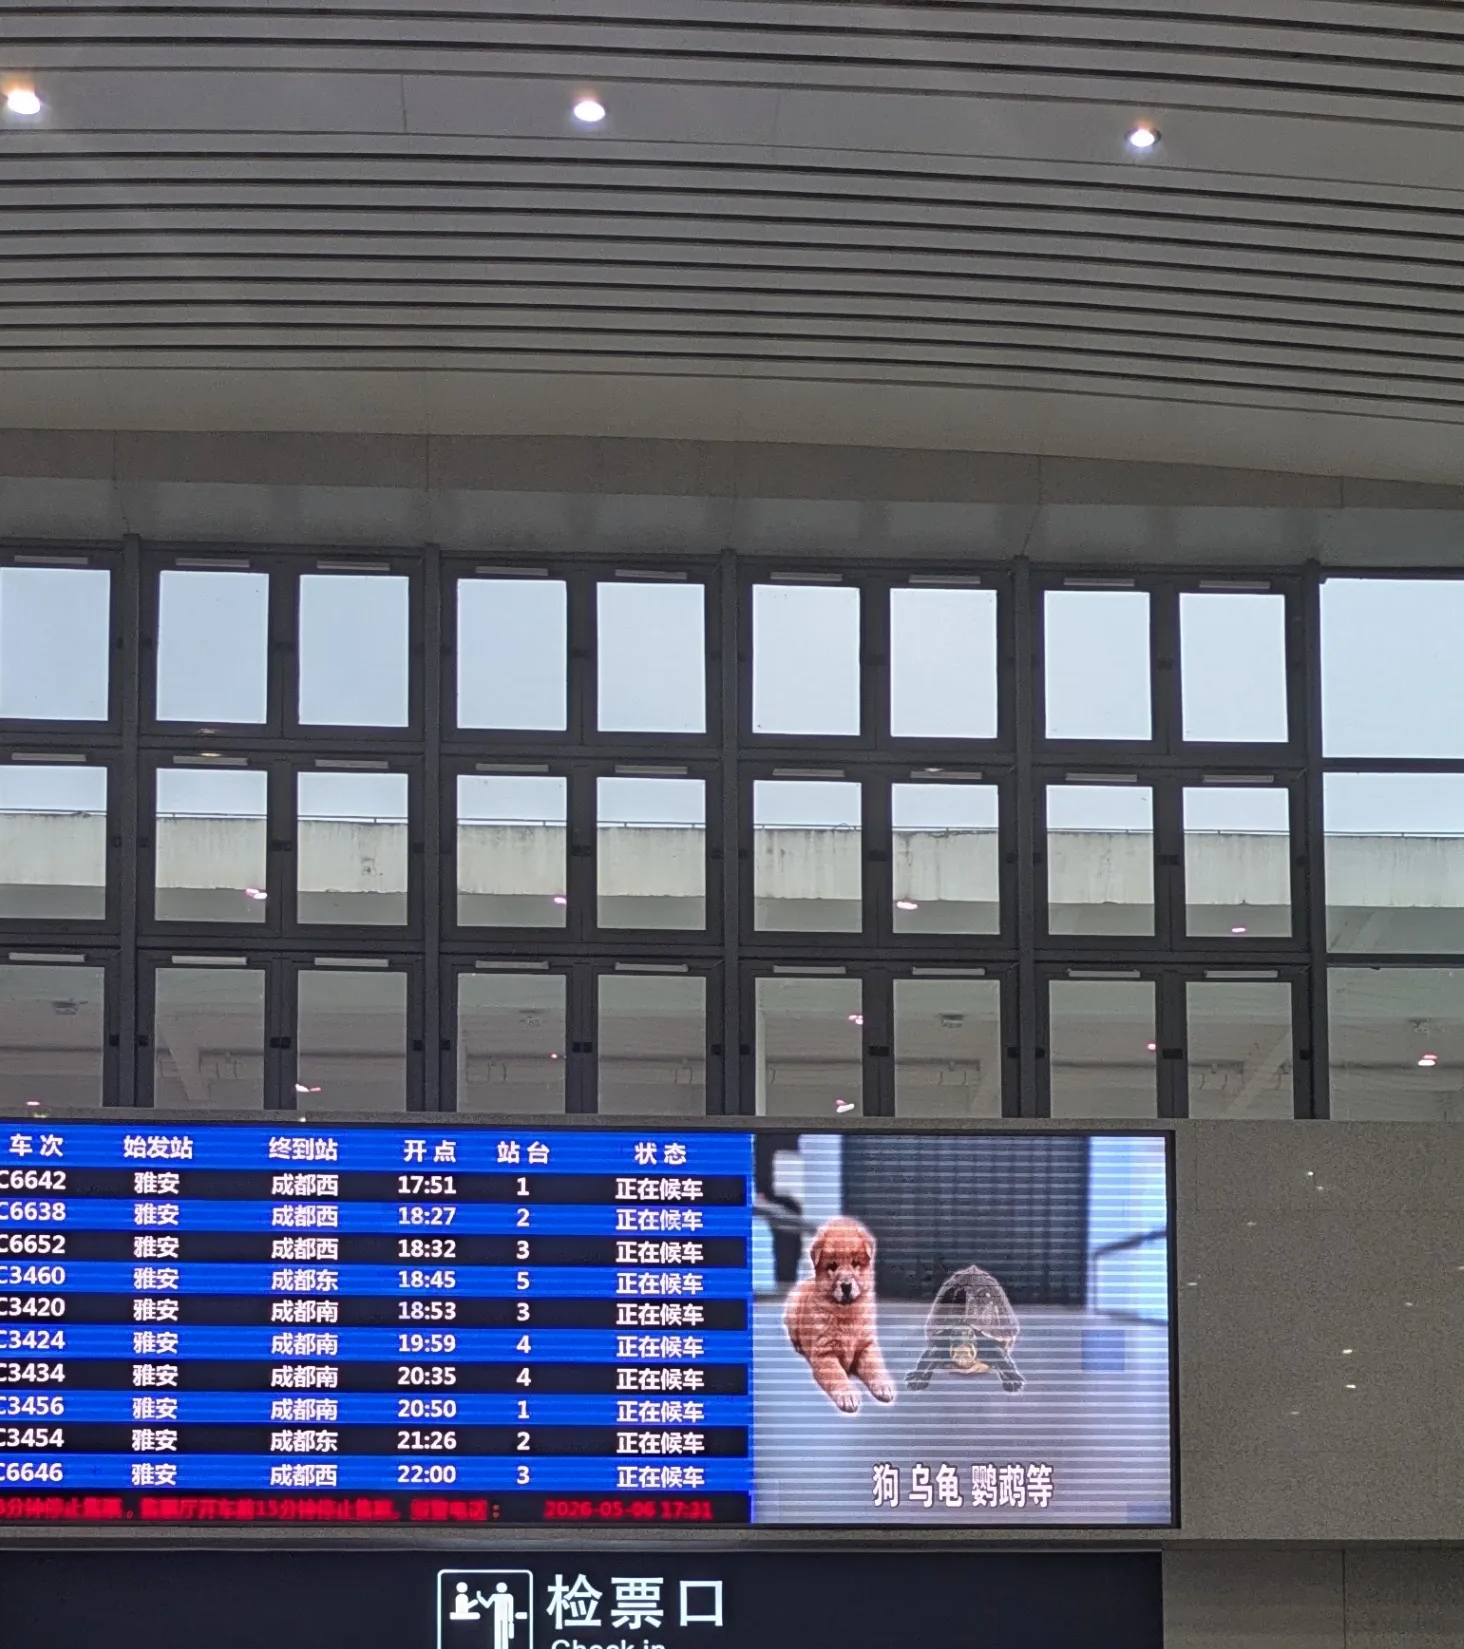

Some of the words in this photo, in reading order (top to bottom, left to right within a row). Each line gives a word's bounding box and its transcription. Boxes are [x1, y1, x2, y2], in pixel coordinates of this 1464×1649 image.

[124, 1136, 193, 1159] 始发站
[269, 1137, 337, 1160] 终到站
[134, 1172, 179, 1194] 雅安
[272, 1173, 338, 1196] 成都西
[399, 1176, 456, 1194] 17:51
[517, 1177, 529, 1195] 1
[615, 1178, 703, 1200] 正在候车
[134, 1203, 179, 1225] 雅安
[272, 1205, 338, 1227] 成都西
[399, 1207, 456, 1225] 18:27
[517, 1209, 529, 1226] 2
[616, 1209, 703, 1231] 正在候车
[134, 1236, 179, 1258] 雅安
[272, 1237, 338, 1260] 成都西
[399, 1240, 455, 1257] 18:32
[517, 1241, 529, 1259] 3
[616, 1241, 703, 1263] 正在候车
[134, 1267, 179, 1289] 雅安
[272, 1269, 338, 1291] 成都东
[399, 1271, 455, 1288] 18:45
[518, 1272, 529, 1289] 5
[616, 1273, 703, 1294] 正在候车
[134, 1299, 178, 1321] 雅安
[271, 1300, 338, 1322] 成都南
[399, 1302, 456, 1319] 18:53
[517, 1303, 529, 1321] 3
[616, 1303, 704, 1325] 正在候车
[134, 1331, 178, 1353] 雅安
[272, 1332, 338, 1355] 成都南
[399, 1334, 455, 1352] 19:59
[517, 1335, 531, 1353] 4
[617, 1336, 704, 1358] 正在候车
[133, 1364, 178, 1386] 雅安
[271, 1365, 338, 1387] 成都南
[398, 1367, 456, 1385] 20:35
[517, 1368, 531, 1386] 4
[616, 1368, 704, 1390] 正在候车
[133, 1397, 177, 1419] 雅安
[271, 1398, 338, 1420] 成都南
[398, 1400, 456, 1417] 20:50
[518, 1401, 529, 1418] 1
[617, 1401, 704, 1422] 正在候车
[132, 1429, 177, 1451] 雅安
[271, 1430, 338, 1452] 成都东
[398, 1431, 456, 1449] 21:26
[517, 1432, 529, 1450] 2
[617, 1432, 704, 1454] 正在候车
[132, 1463, 176, 1485] 雅安
[271, 1464, 337, 1486] 成都西
[398, 1465, 456, 1483] 22:00
[517, 1466, 529, 1484] 3
[617, 1466, 704, 1488] 正在候车
[873, 1464, 899, 1507] 狗
[909, 1464, 962, 1507] 乌龟
[971, 1464, 1054, 1508] 鹦鹉等
[546, 1573, 724, 1630] 检票口
